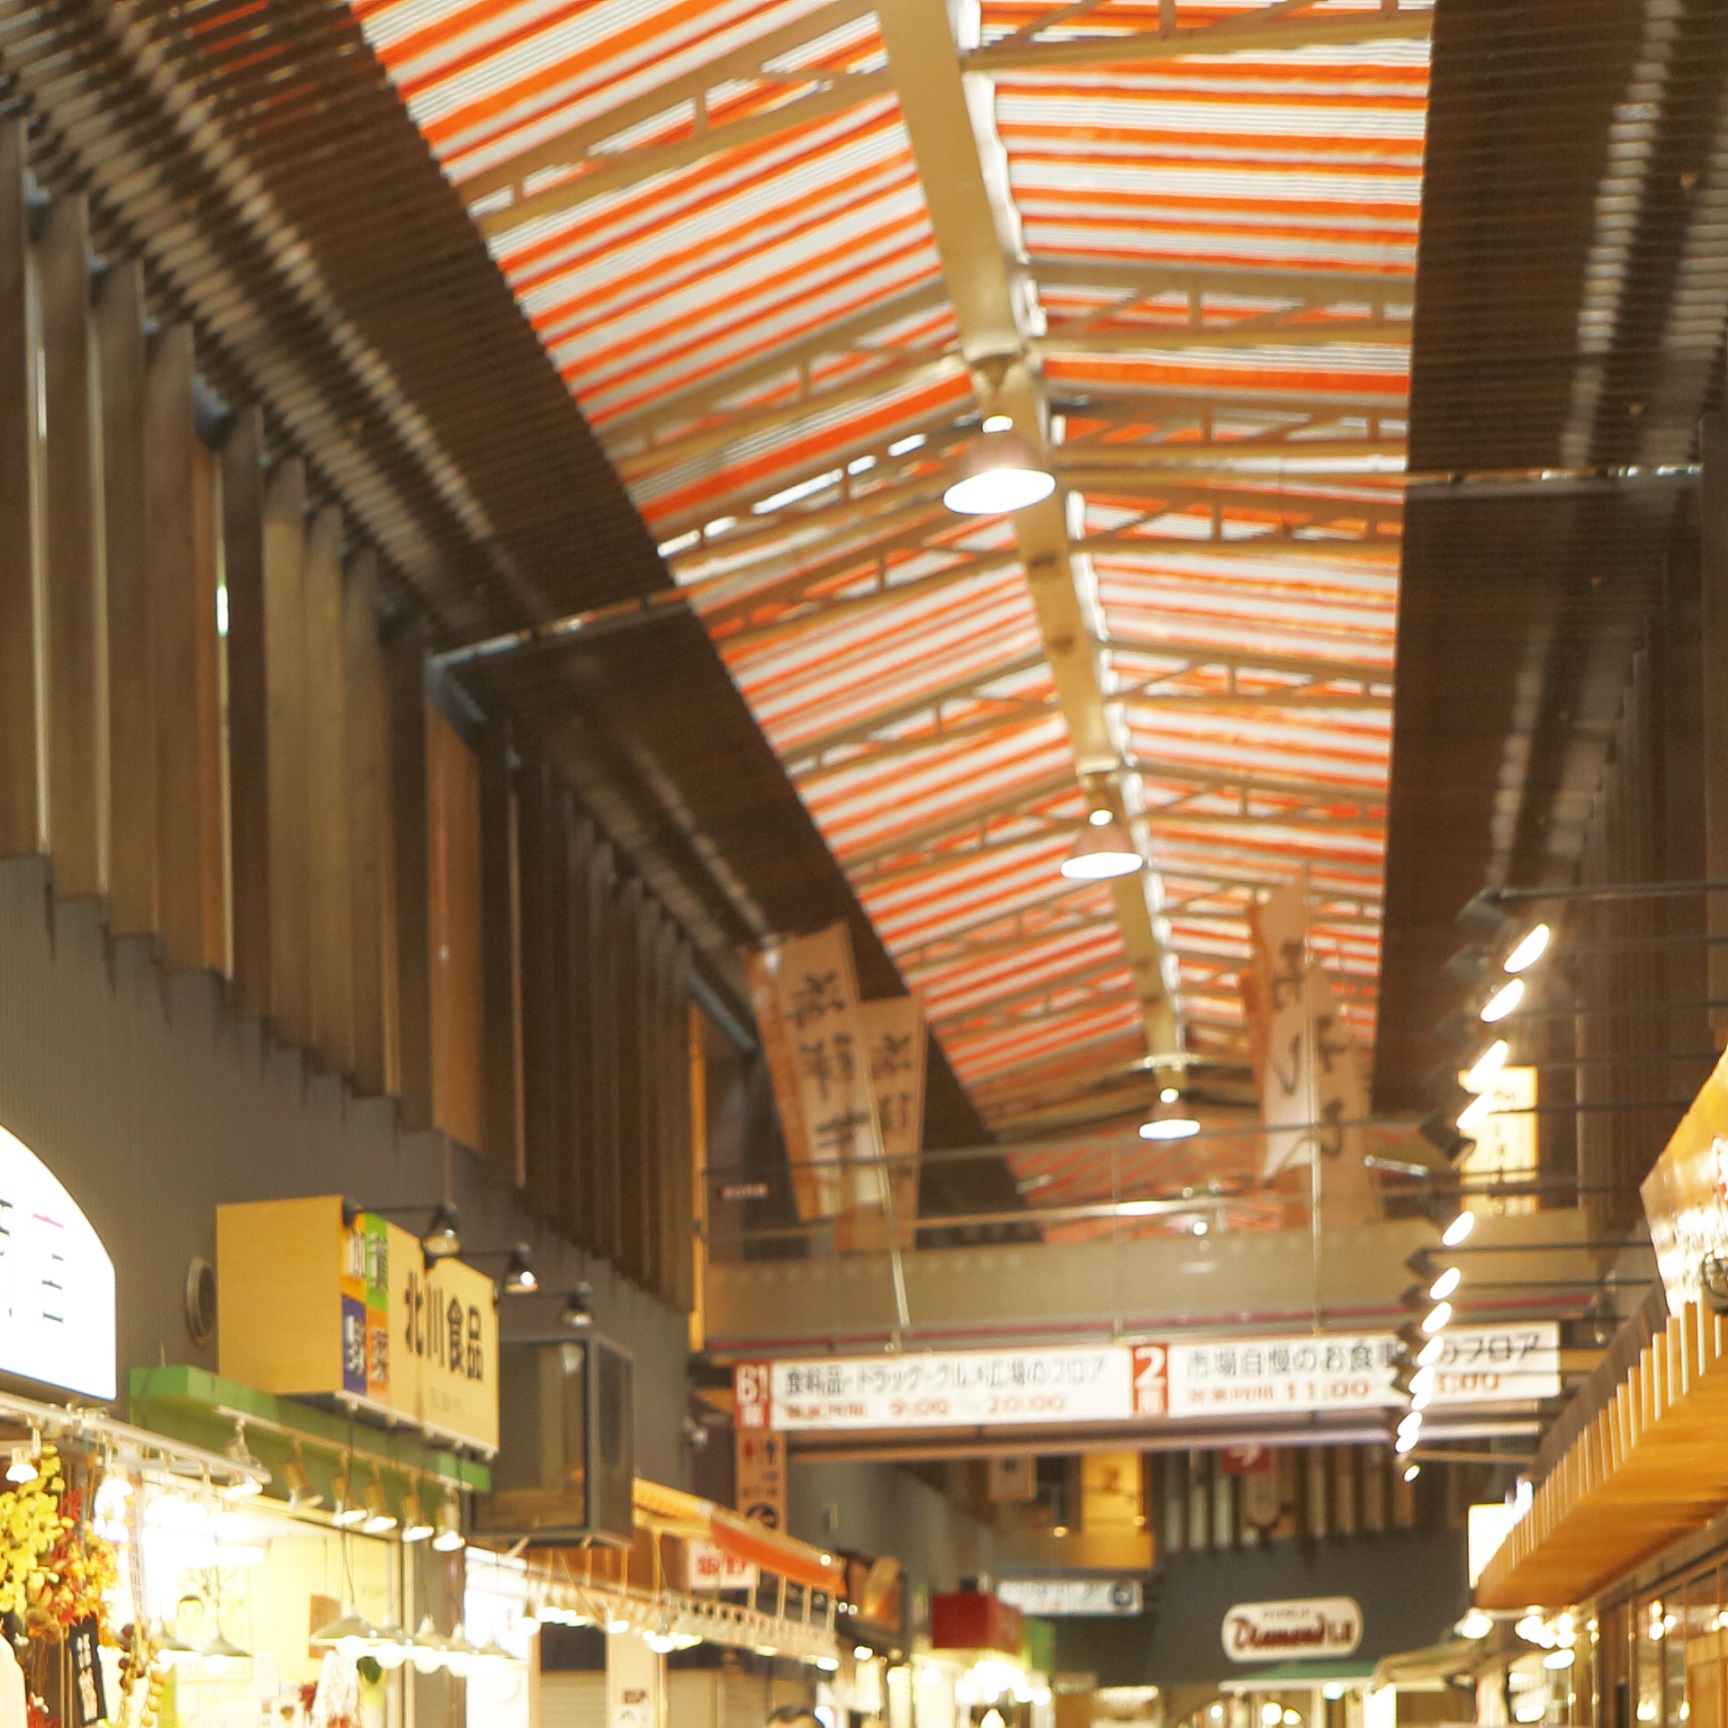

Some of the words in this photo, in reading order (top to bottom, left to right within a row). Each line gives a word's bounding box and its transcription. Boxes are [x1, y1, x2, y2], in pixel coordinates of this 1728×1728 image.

[405, 1270, 484, 1382] 北川食品
[1135, 1348, 1166, 1383] 2
